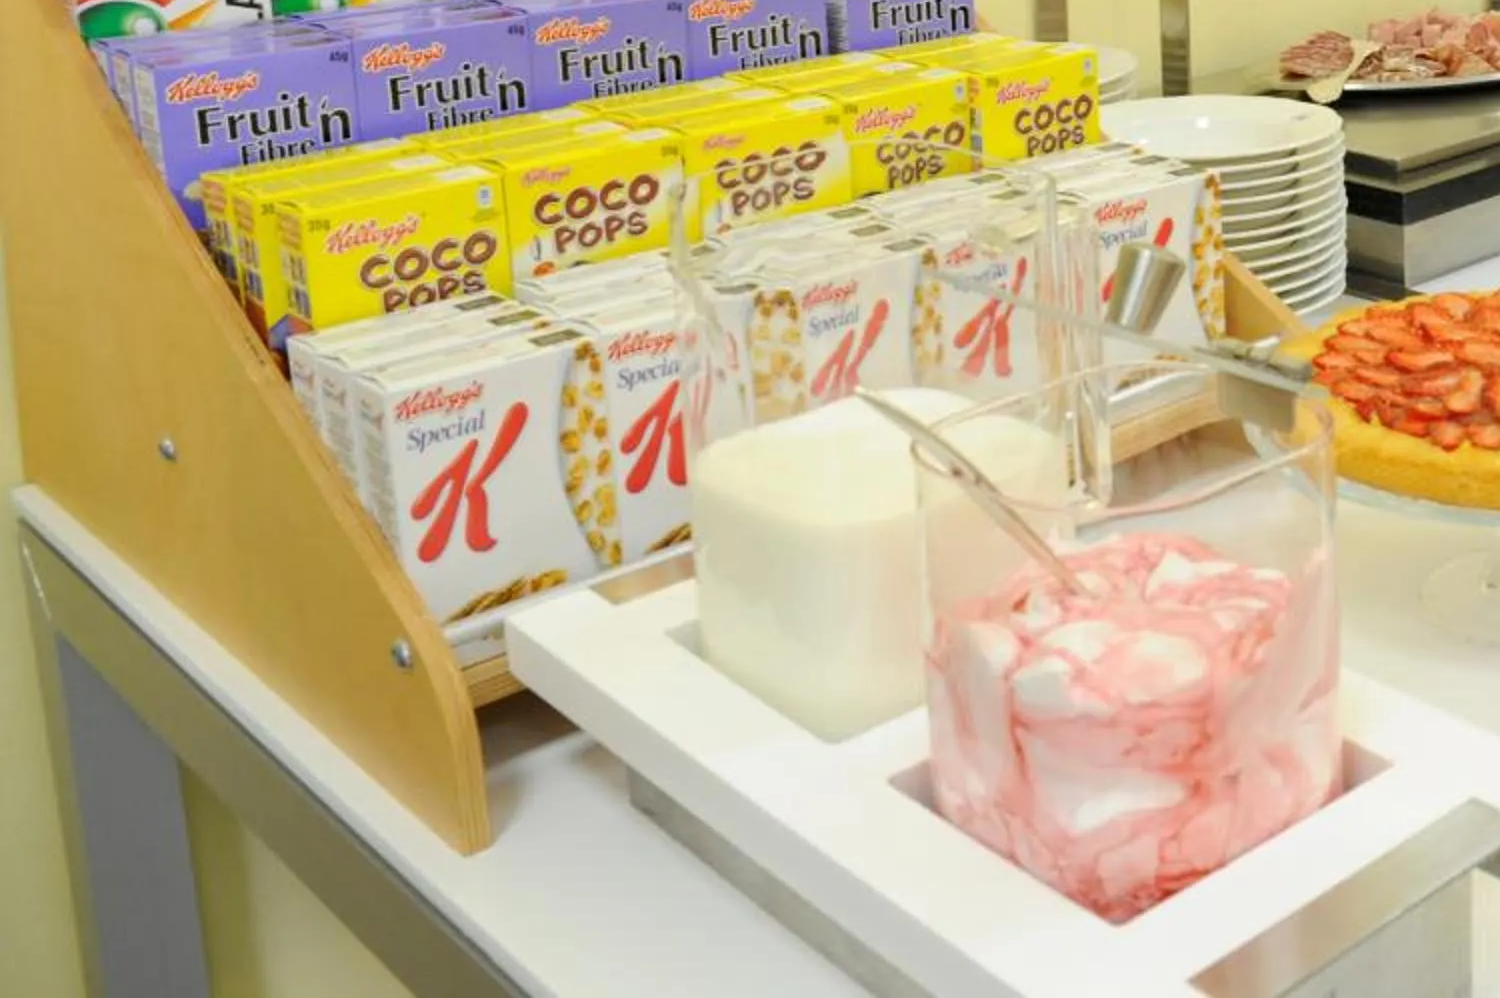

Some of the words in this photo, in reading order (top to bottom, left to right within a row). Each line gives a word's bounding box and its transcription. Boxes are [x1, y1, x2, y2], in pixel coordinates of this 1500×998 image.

[708, 15, 792, 56] Fruit
[363, 42, 445, 72] Kellogg's
[558, 37, 650, 83] Fruit
[166, 70, 260, 104] Kellogg's
[388, 62, 491, 112] Fruit
[196, 93, 312, 145] Fruit
[426, 106, 493, 131] Fibre
[1014, 94, 1093, 134] COCO
[239, 138, 316, 165] Fibre
[1027, 125, 1085, 157] POPS
[715, 140, 827, 189] COCO
[888, 154, 945, 189] POPS
[534, 174, 660, 224] COCO
[731, 177, 815, 216] POPS
[555, 211, 648, 253] POPS
[360, 230, 497, 289] COCO
[383, 269, 486, 313] POPS
[616, 358, 681, 392] Specia
[394, 380, 484, 421] Kellogg's
[407, 408, 486, 453] Special
[410, 401, 529, 563] K
